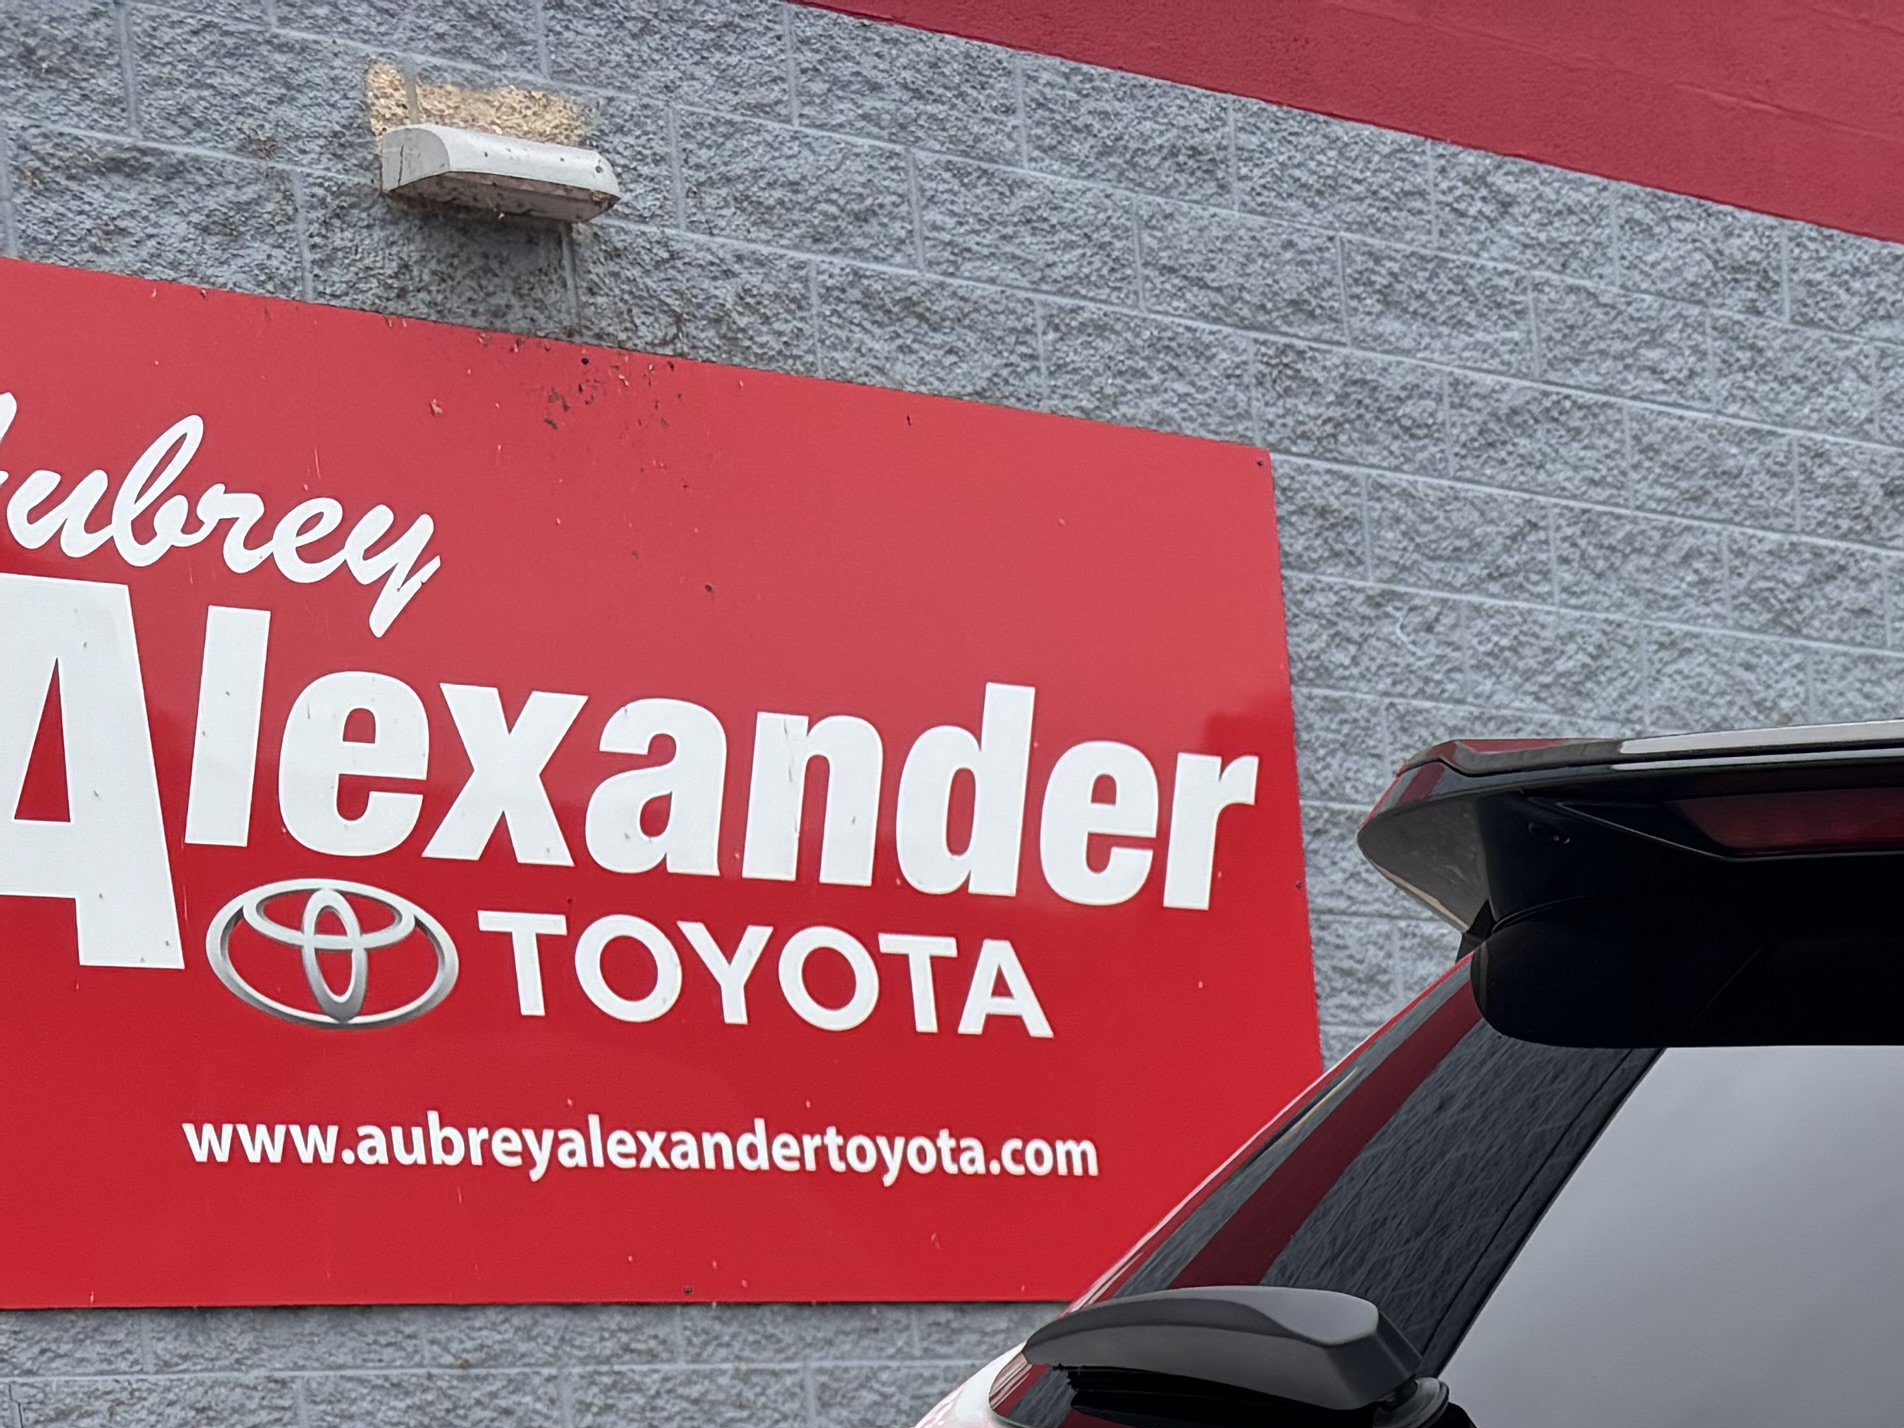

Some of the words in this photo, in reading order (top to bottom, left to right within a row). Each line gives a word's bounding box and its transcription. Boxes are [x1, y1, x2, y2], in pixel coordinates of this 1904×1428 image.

[0, 392, 441, 638] ubrey
[0, 573, 1259, 969] Alexander
[478, 910, 1053, 1038] TOYOTA
[183, 1110, 1098, 1187] www.aubreyalexandertoyota.com
